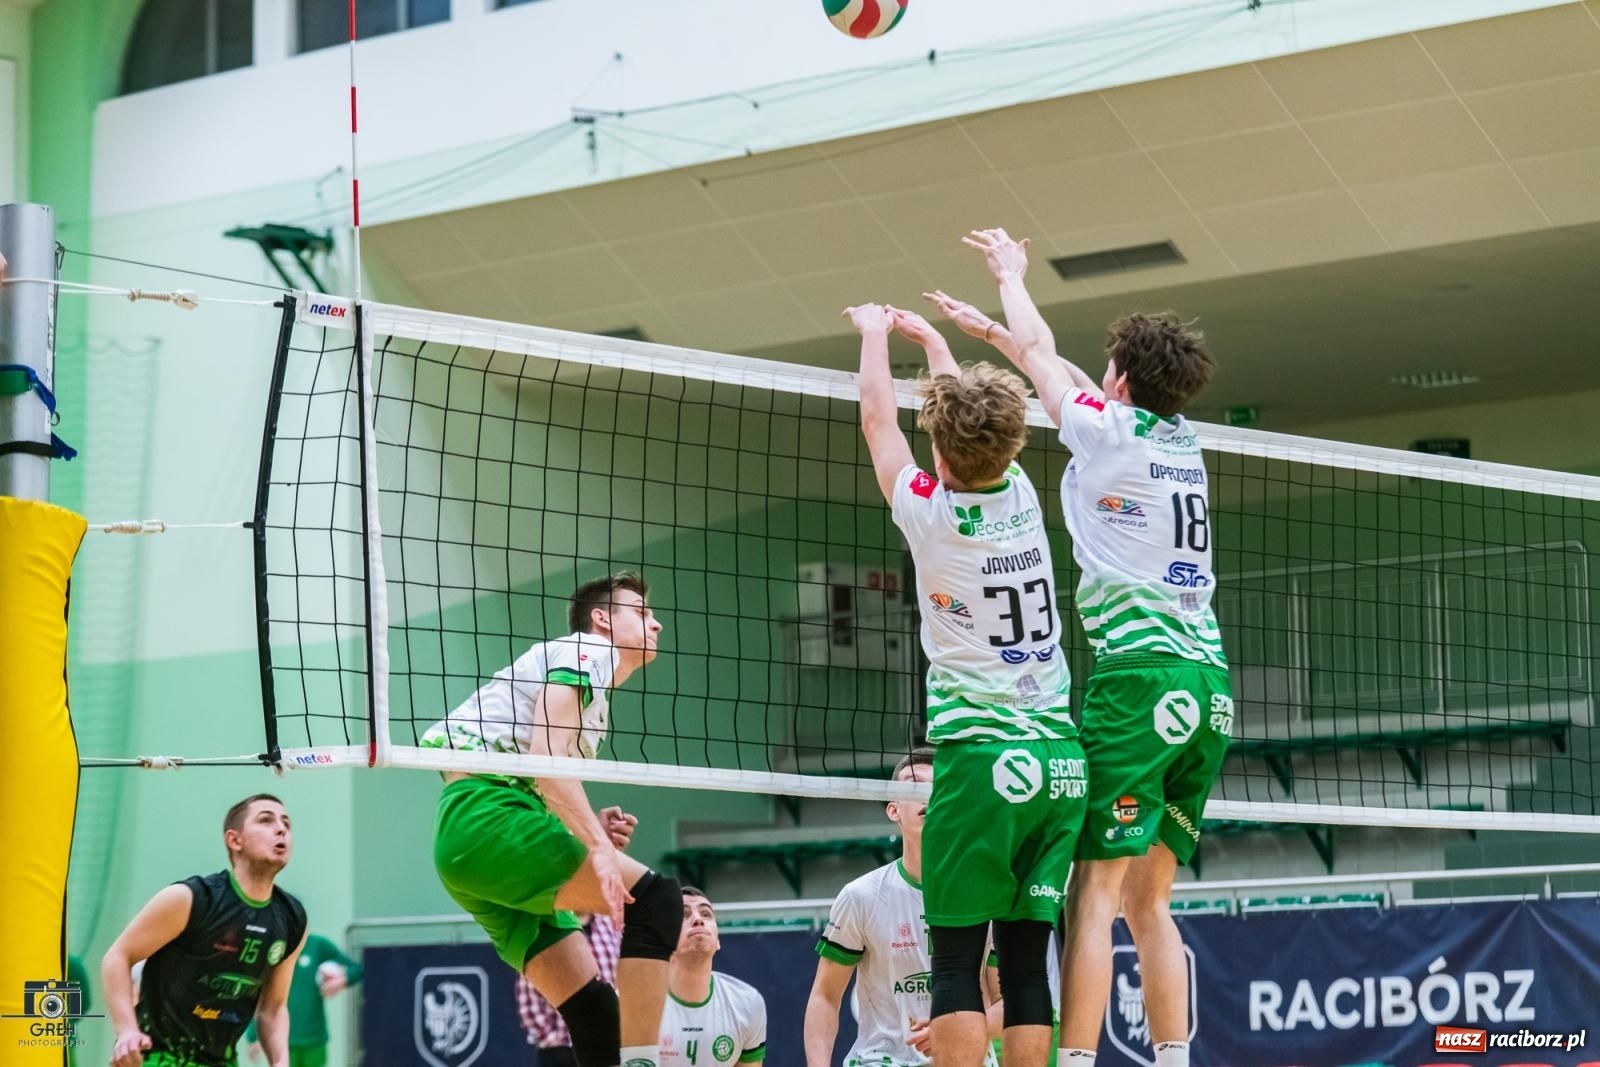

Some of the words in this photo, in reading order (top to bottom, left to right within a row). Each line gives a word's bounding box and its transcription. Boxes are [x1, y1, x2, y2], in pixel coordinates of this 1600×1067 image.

[310, 303, 347, 318] netex
[1172, 491, 1208, 553] 18
[981, 547, 1043, 575] JAWURA
[983, 577, 1053, 648] 33
[295, 752, 333, 765] netex
[1249, 955, 1536, 1032] RACIBÓRZ
[686, 1039, 698, 1066] 4
